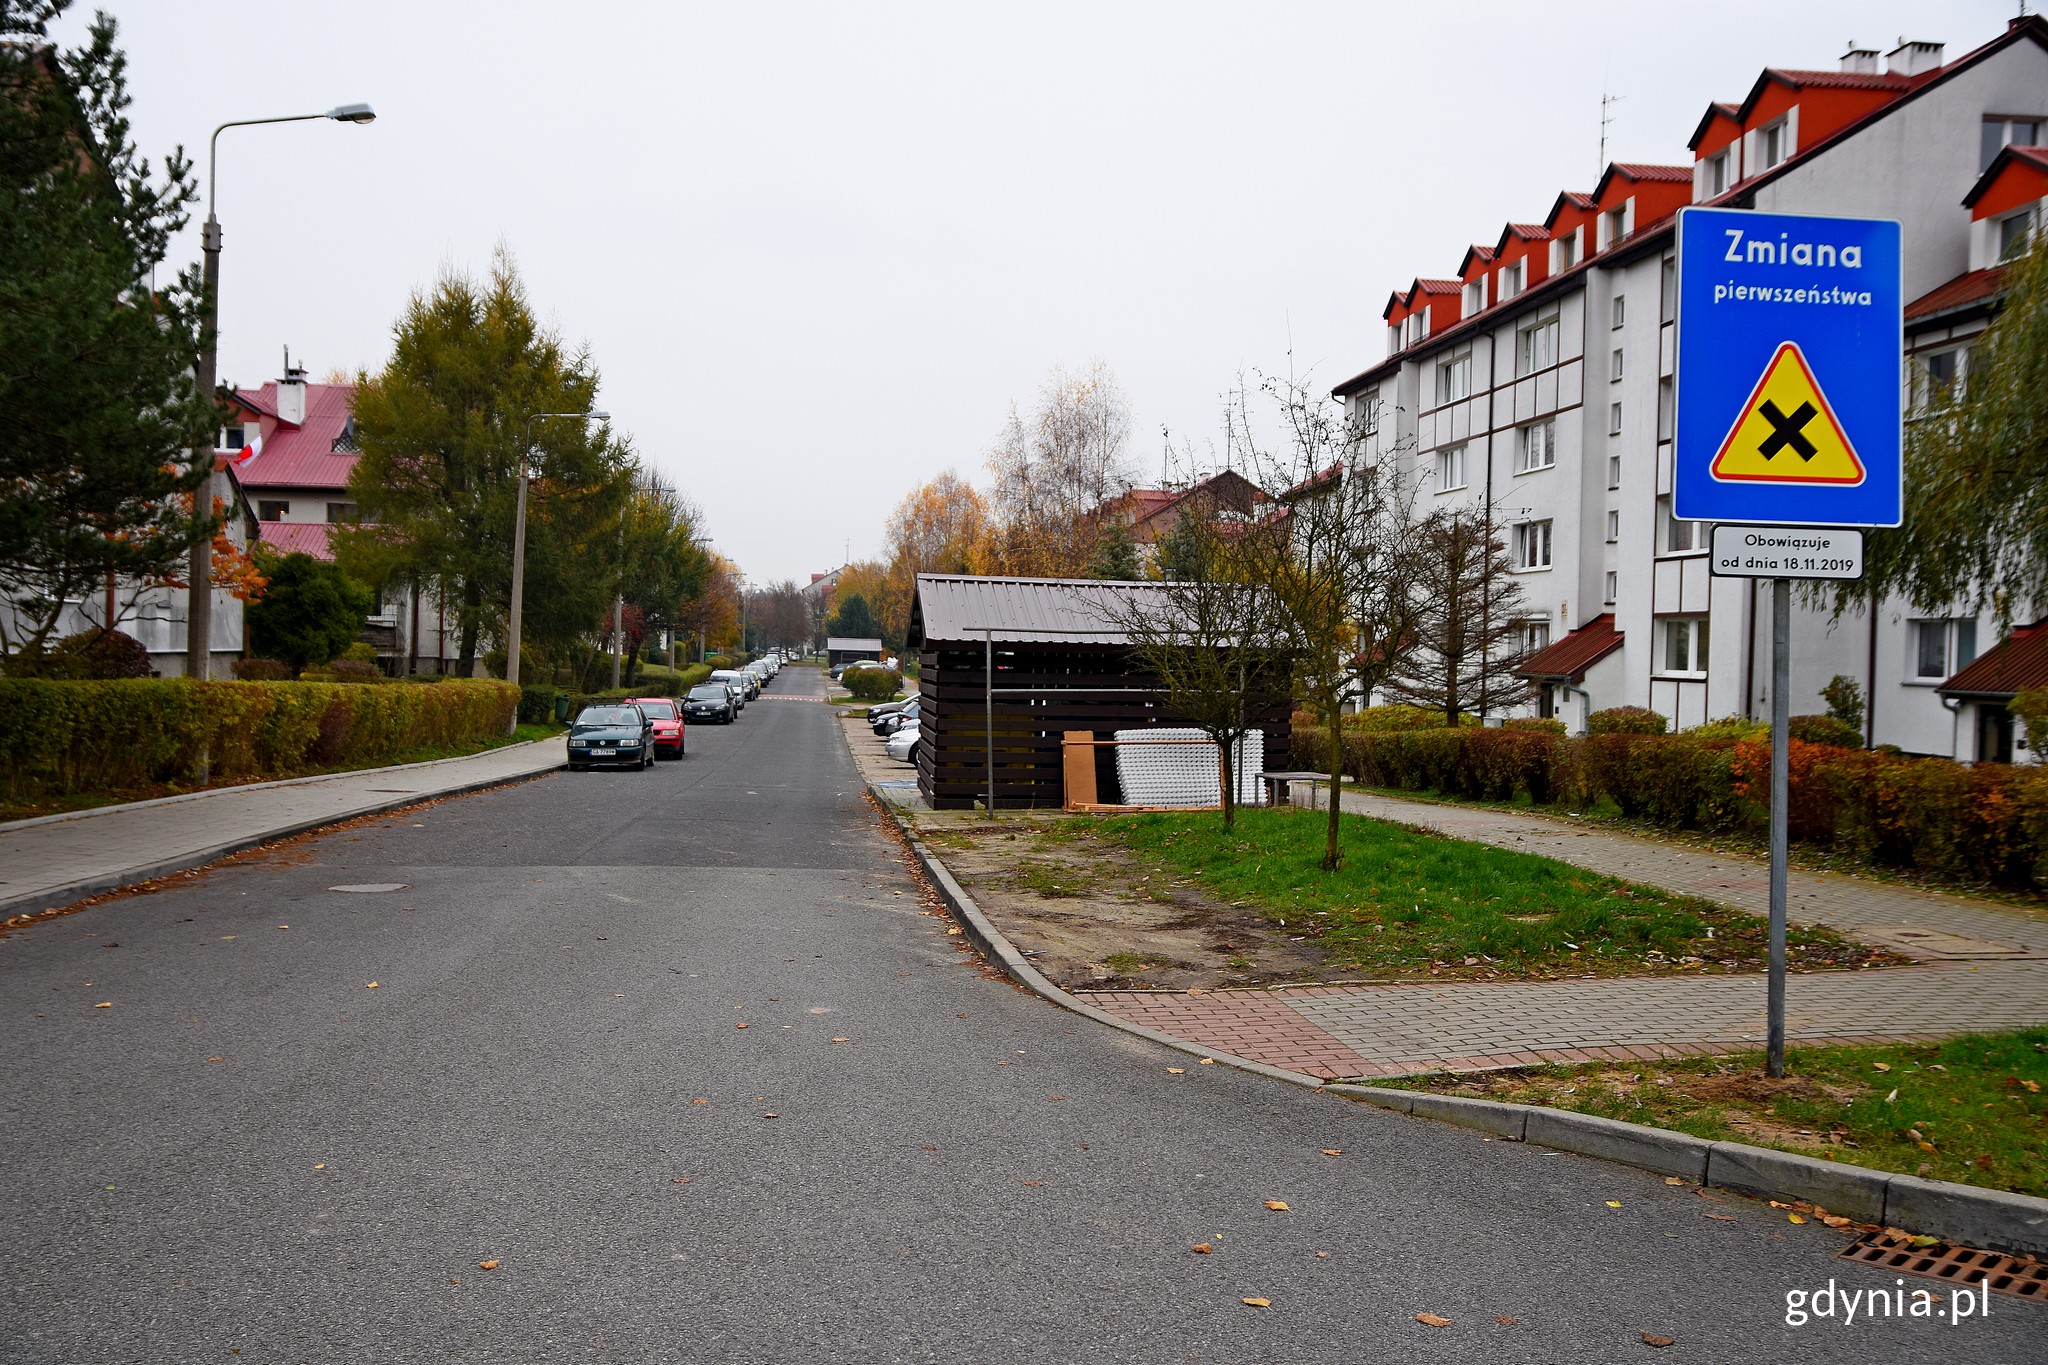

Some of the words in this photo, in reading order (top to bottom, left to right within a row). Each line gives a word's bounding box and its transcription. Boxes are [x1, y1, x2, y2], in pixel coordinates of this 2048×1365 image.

[1724, 229, 1862, 268] Zmiana
[1714, 279, 1872, 306] pierwszeństwa
[1744, 533, 1831, 551] Obowiązuje
[1721, 556, 1740, 568] od
[1745, 556, 1778, 569] dnia
[1783, 557, 1854, 572] 18.11.2019
